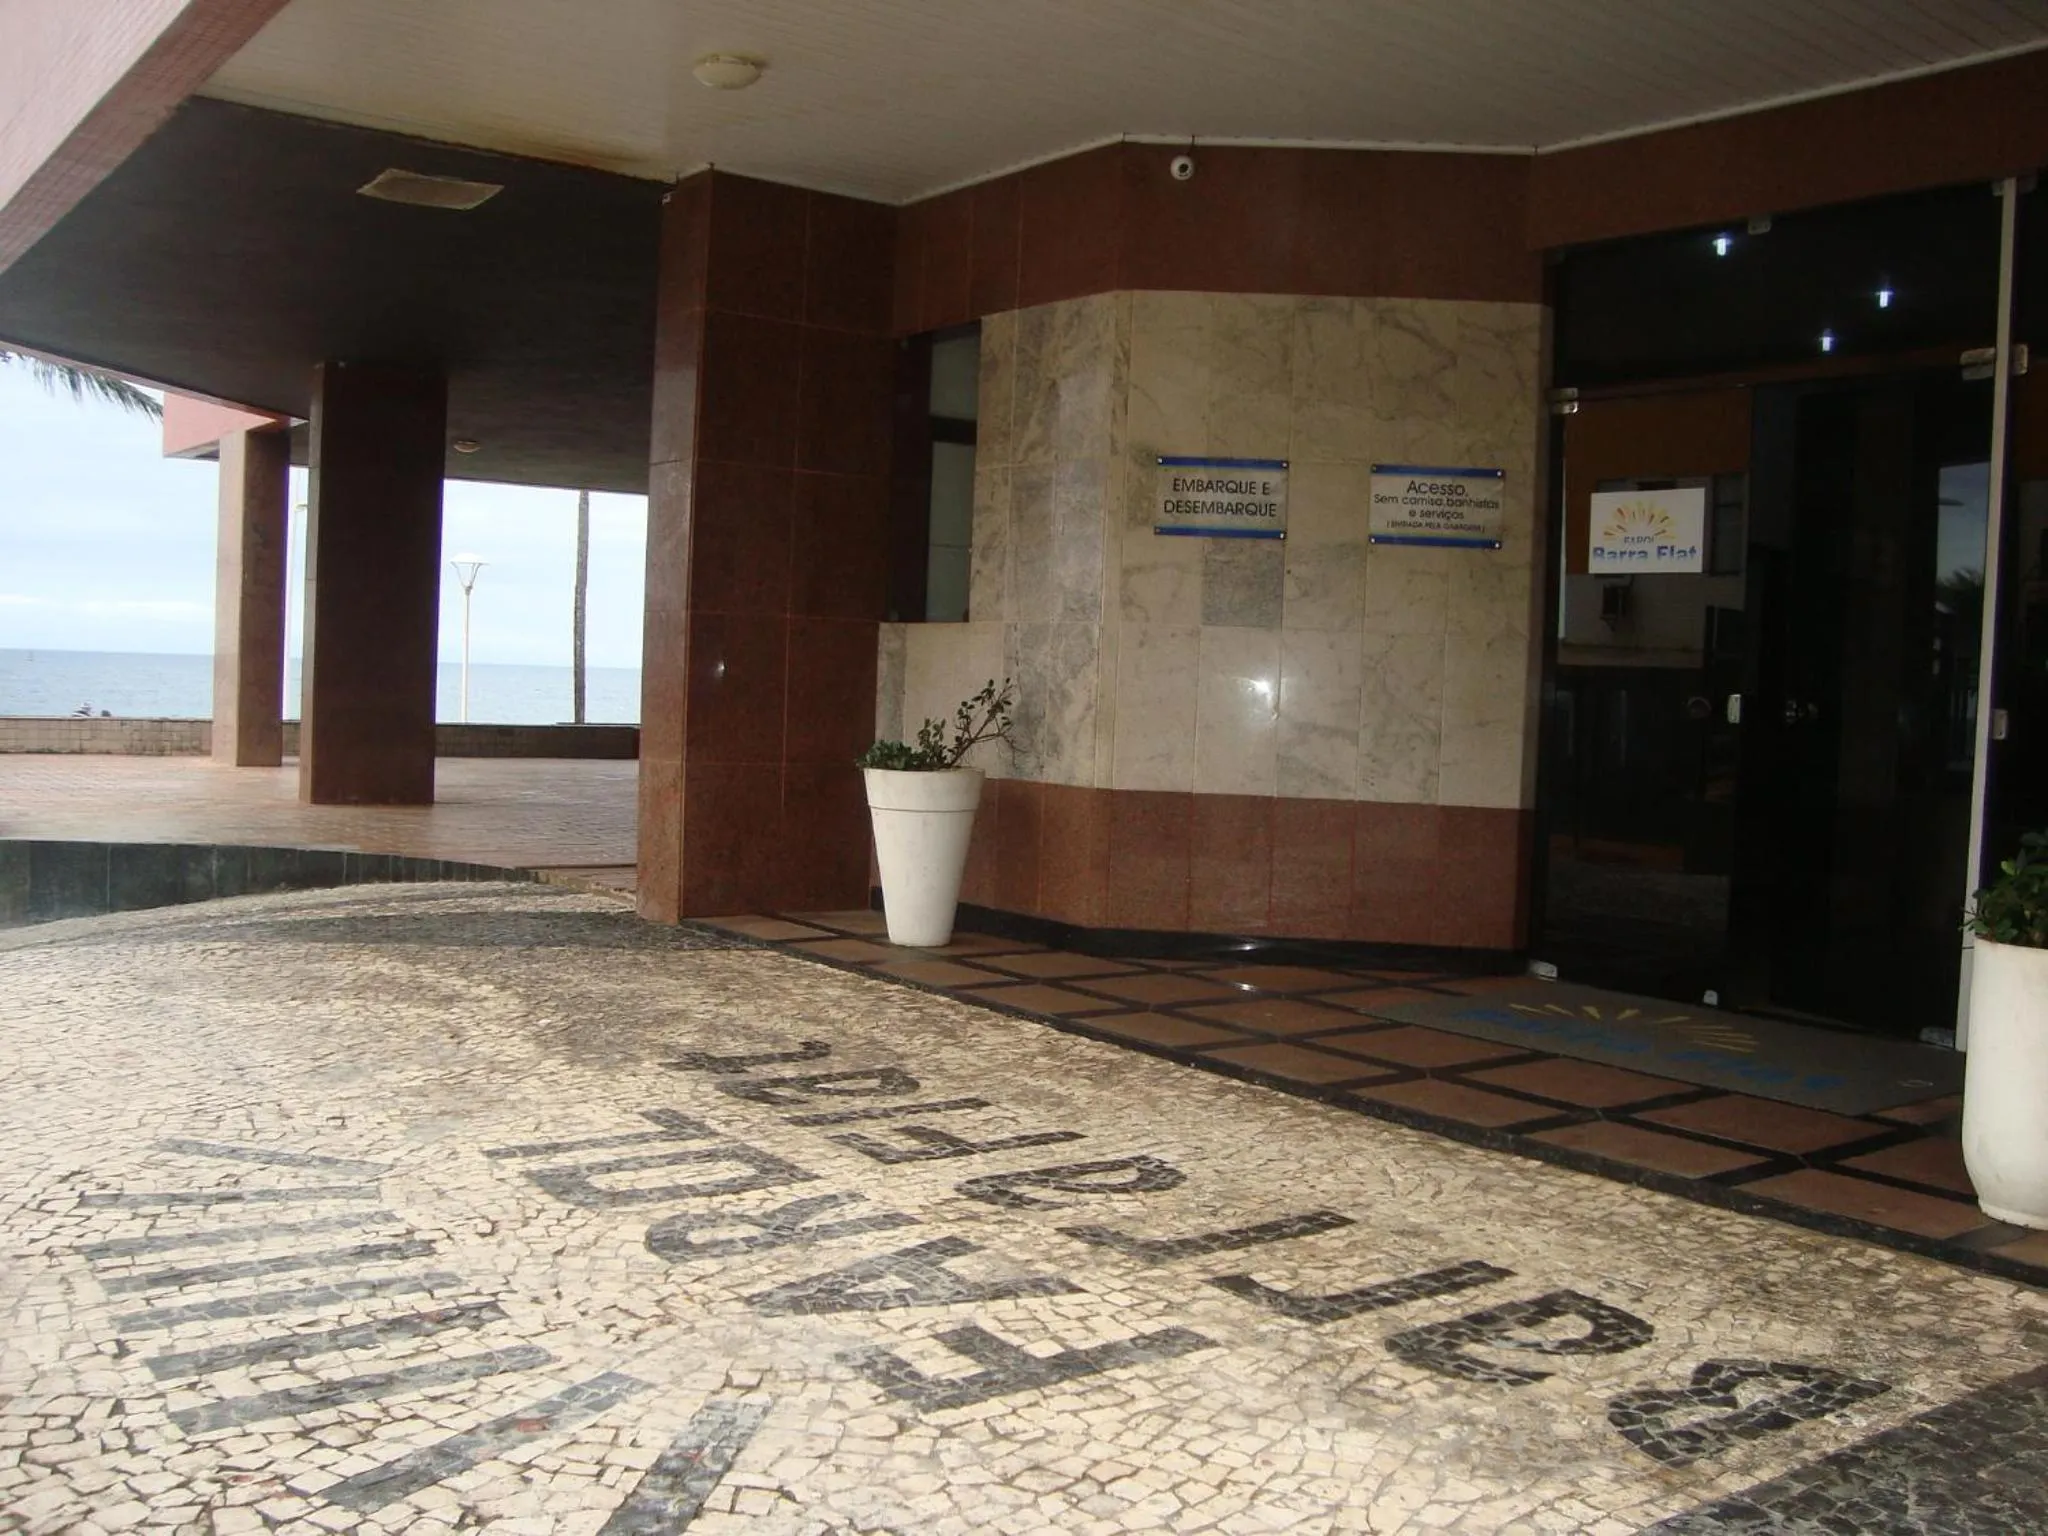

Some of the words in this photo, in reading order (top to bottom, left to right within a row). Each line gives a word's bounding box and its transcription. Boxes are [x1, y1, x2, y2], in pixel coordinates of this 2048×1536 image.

[1172, 477, 1257, 495] EMBARQUE
[1262, 481, 1271, 496] E
[1163, 499, 1278, 517] DESEMBARQUE
